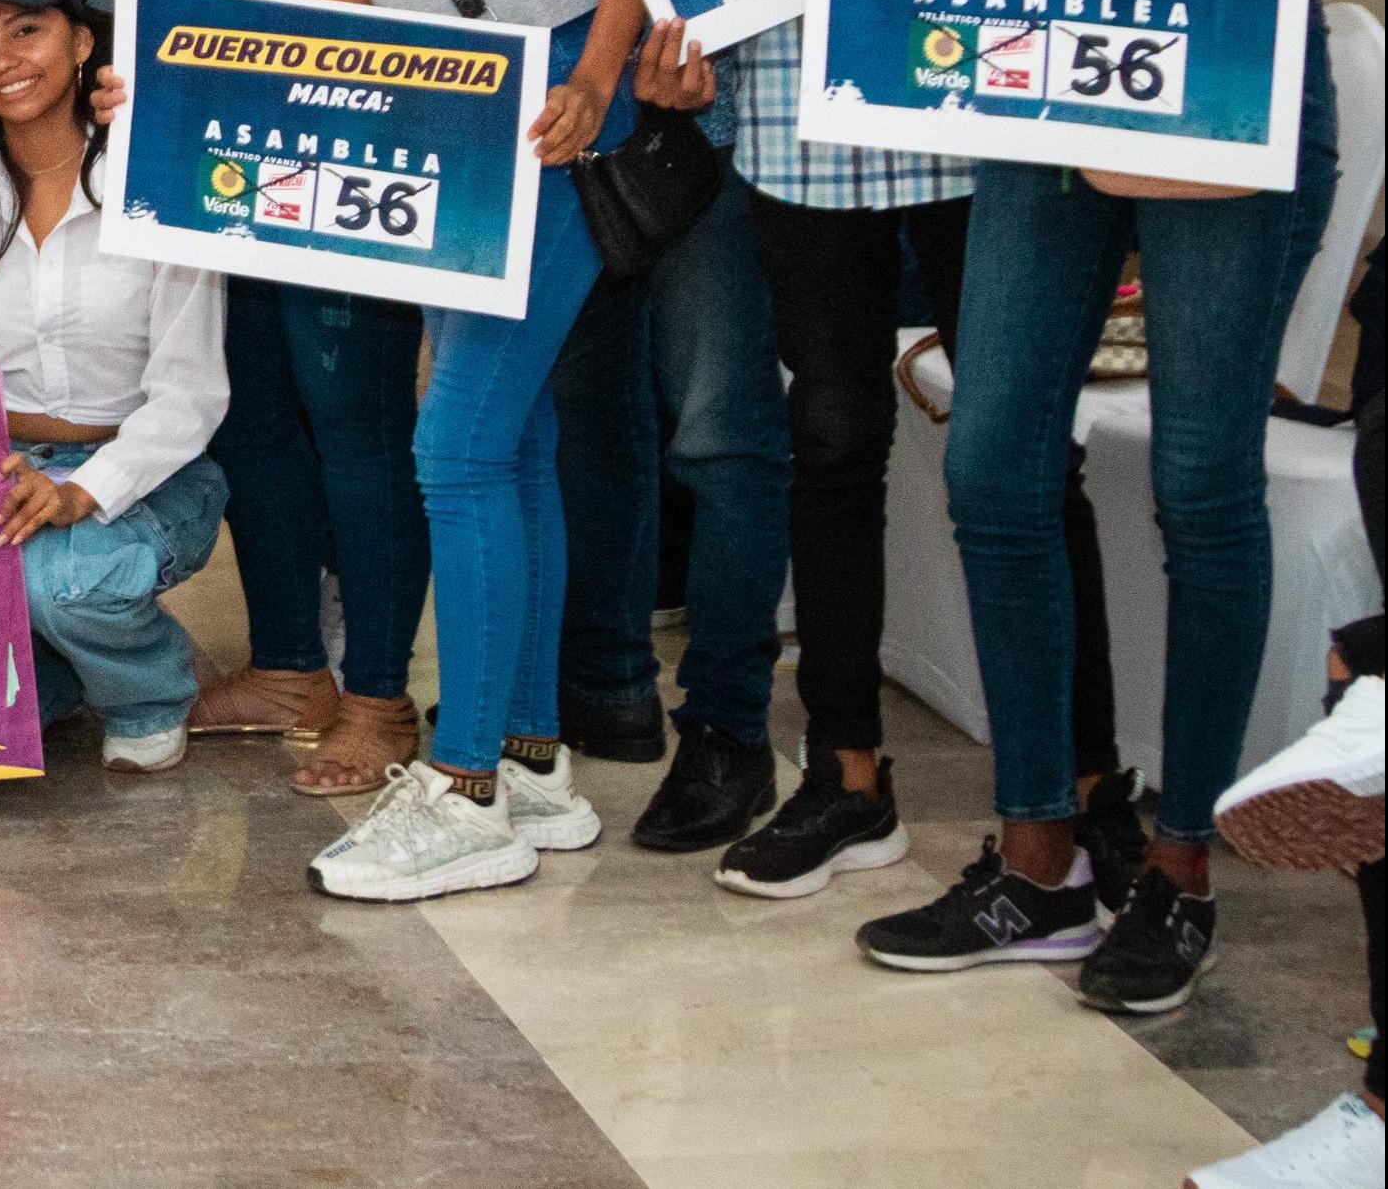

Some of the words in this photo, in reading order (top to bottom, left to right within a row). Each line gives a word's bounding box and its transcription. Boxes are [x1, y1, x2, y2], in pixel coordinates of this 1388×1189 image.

[168, 31, 307, 67] PUERTO
[315, 45, 497, 88] COLOMBIA
[915, 66, 971, 90] Verde
[1070, 33, 1164, 102] 56
[288, 83, 394, 113] MARCA:
[204, 120, 440, 174] ASAMBLEA
[264, 155, 302, 169] AVANZA
[203, 195, 250, 218] Verde
[335, 174, 419, 238] 56
